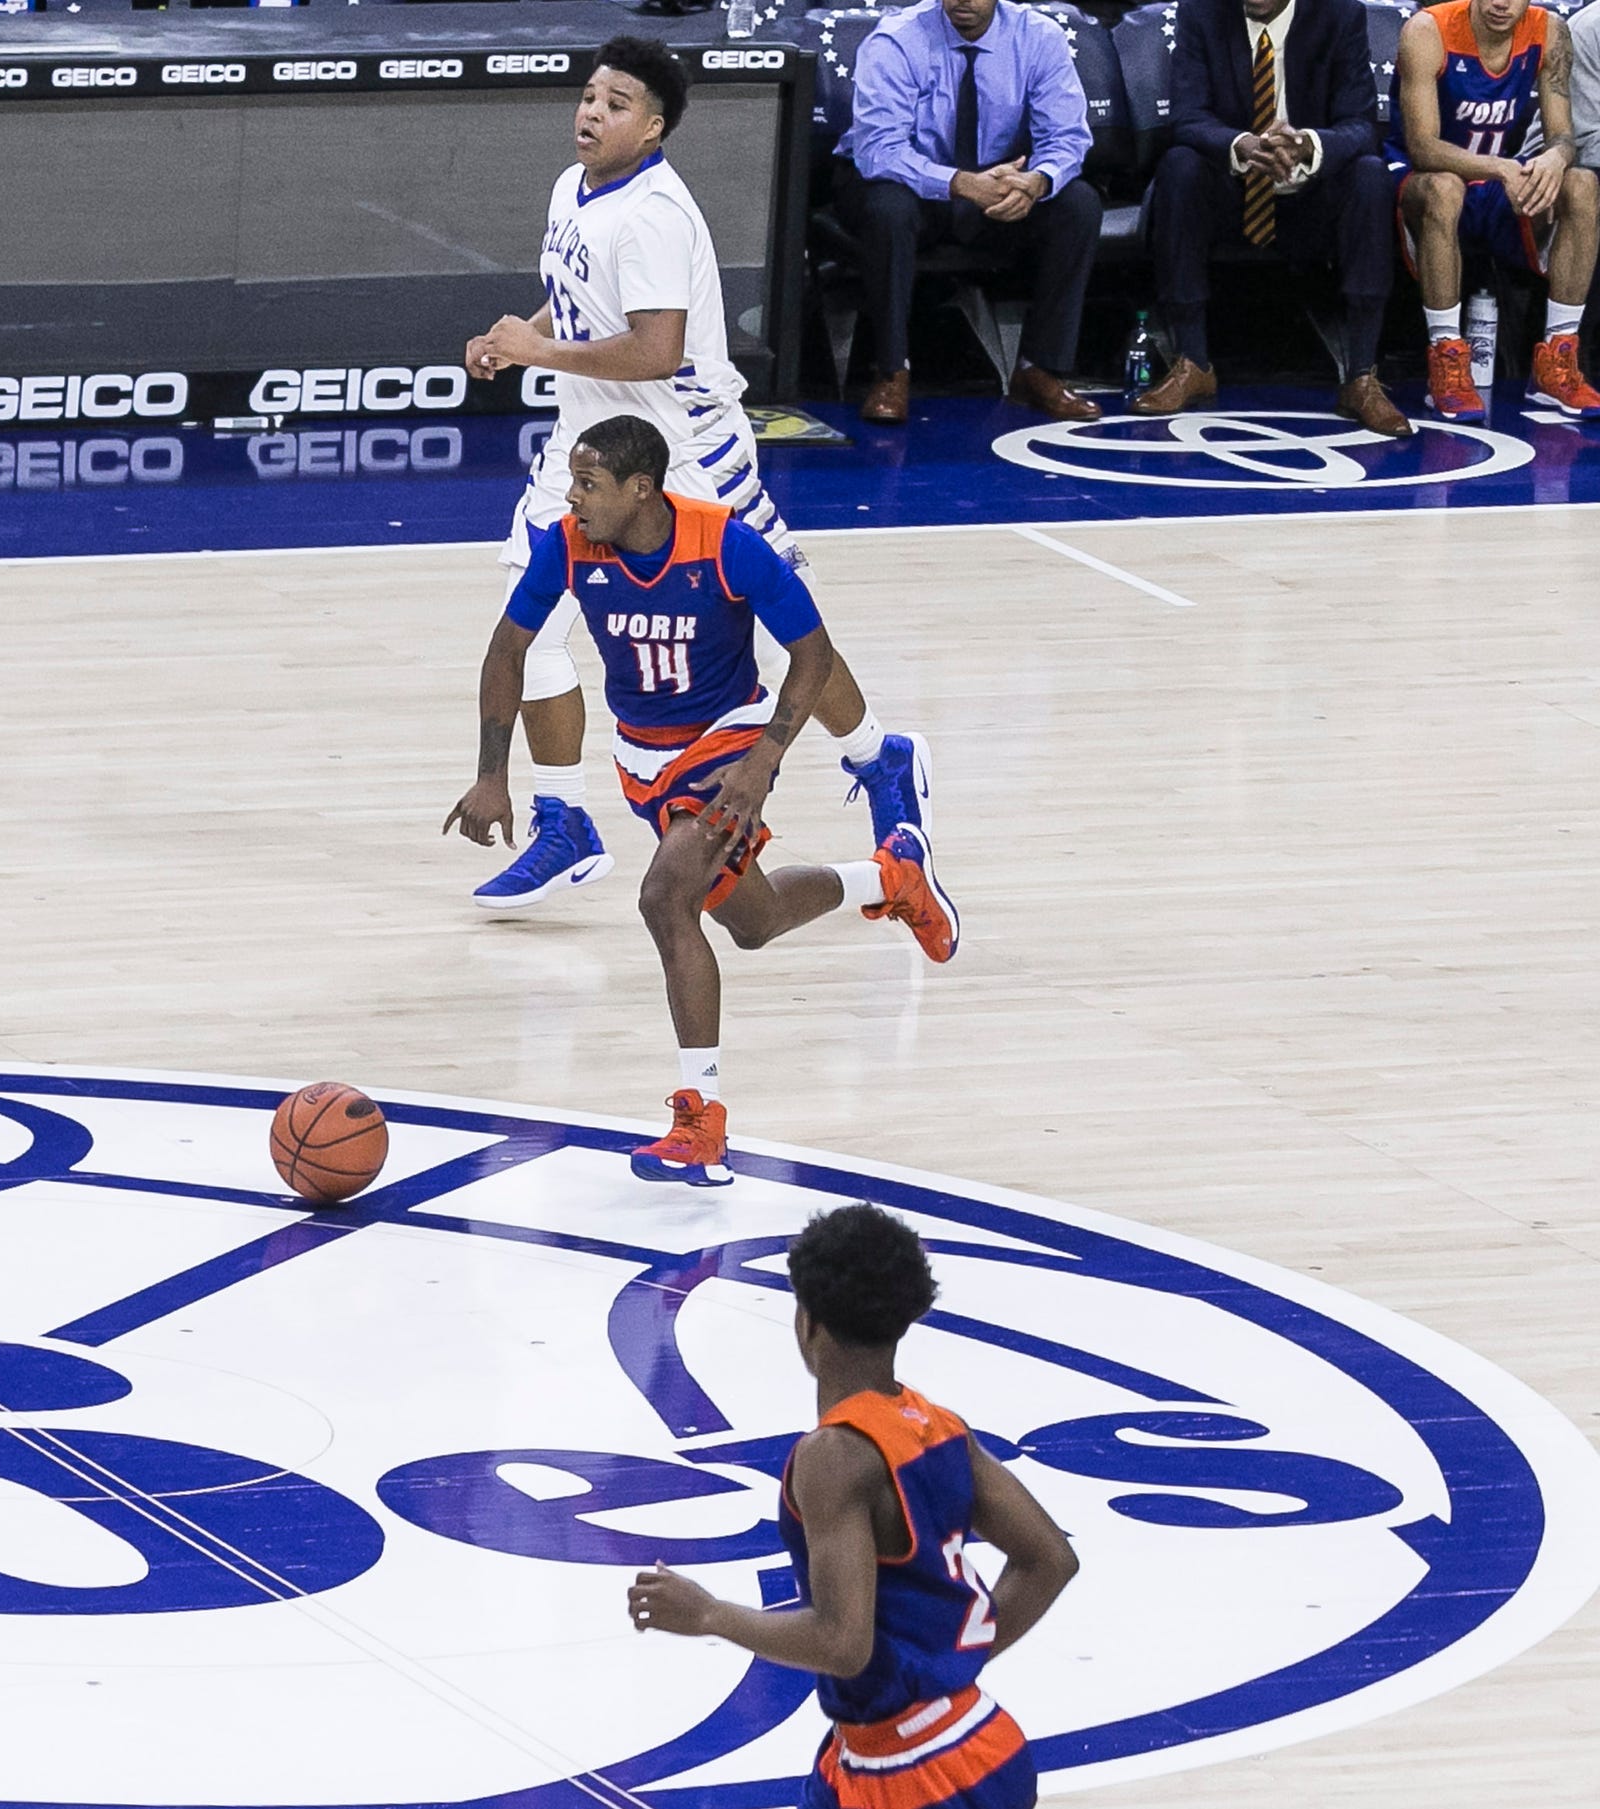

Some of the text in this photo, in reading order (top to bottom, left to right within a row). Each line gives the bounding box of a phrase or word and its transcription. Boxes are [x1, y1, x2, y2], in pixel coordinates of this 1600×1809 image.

[51, 66, 138, 88] GEICO
[161, 64, 247, 85] GEICO
[272, 61, 358, 82] GEICO
[379, 58, 464, 79] GEICO
[486, 54, 571, 74] GEICO
[701, 50, 786, 70] GEICO
[249, 366, 467, 413] GEICO
[607, 613, 697, 640] YORK
[630, 642, 691, 695] 14
